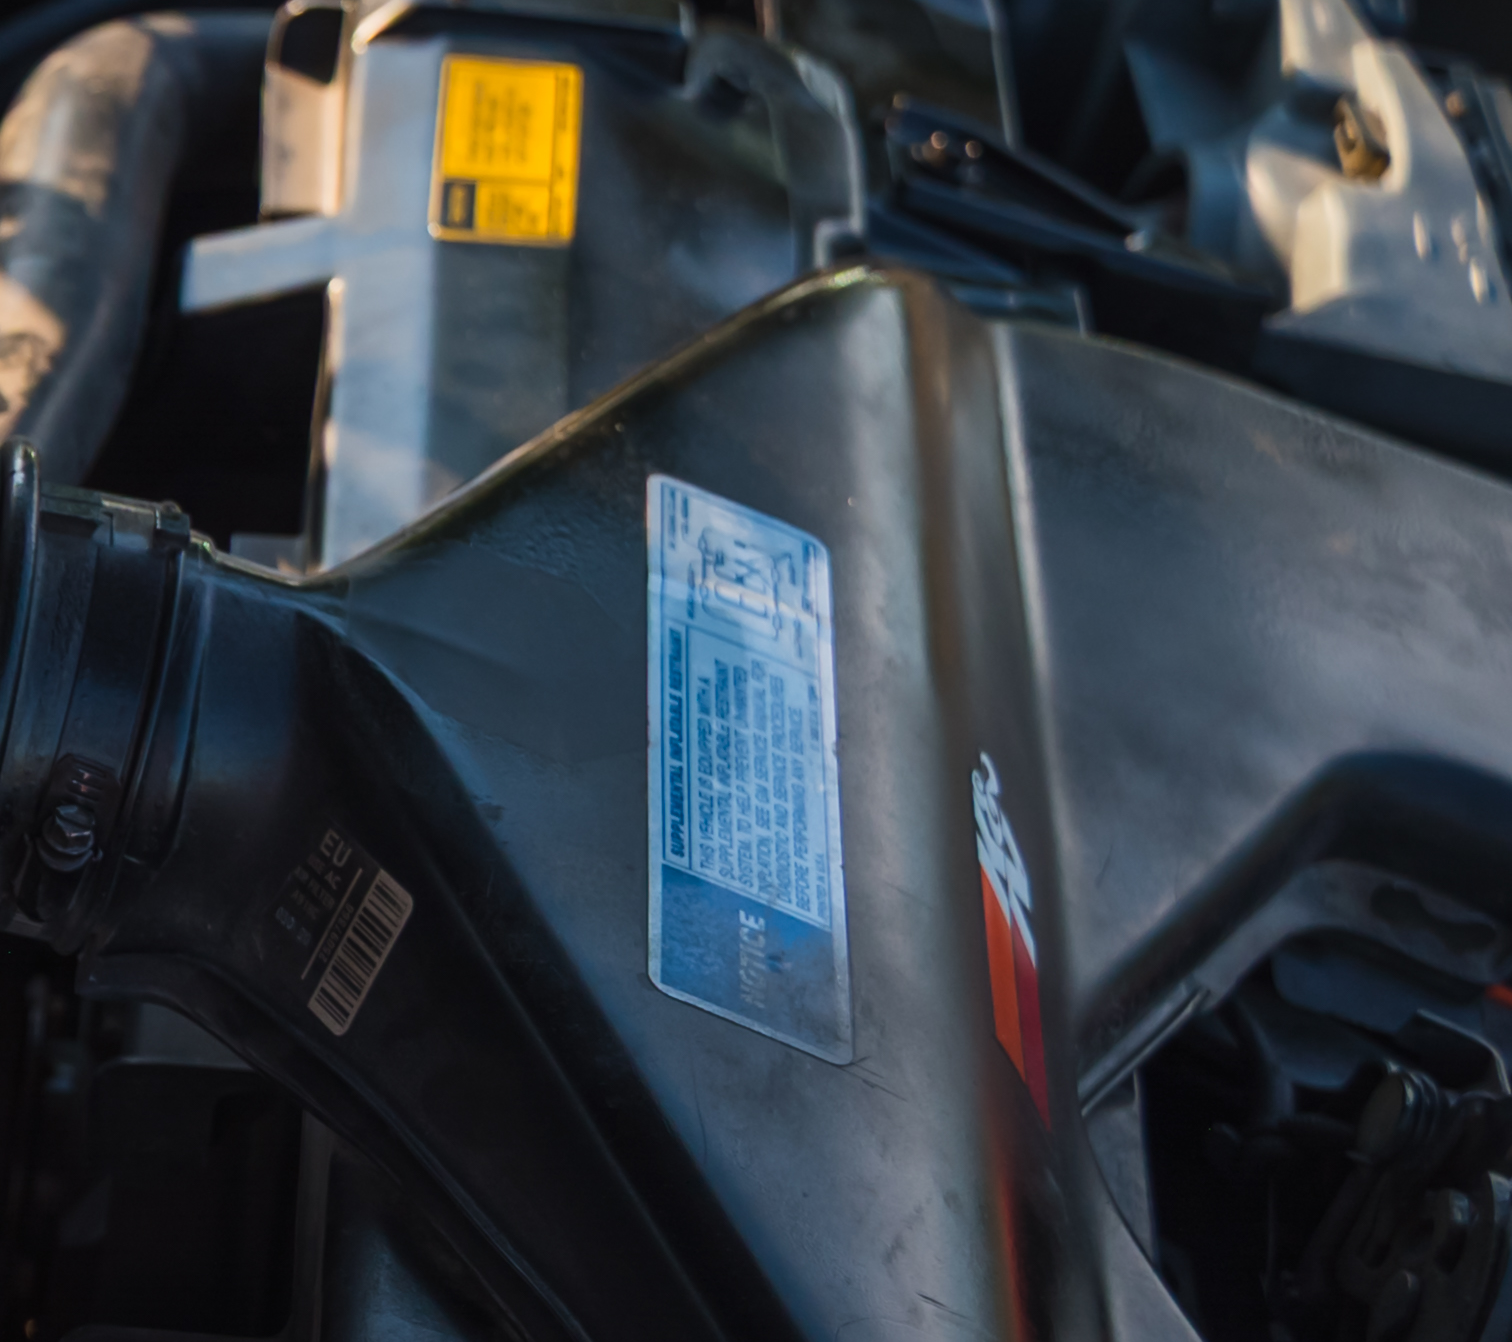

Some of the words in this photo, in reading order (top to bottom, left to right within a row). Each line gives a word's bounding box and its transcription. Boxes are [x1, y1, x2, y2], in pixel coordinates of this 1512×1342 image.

[698, 716, 712, 777] EQUIPPED
[734, 729, 750, 784] PREVENT
[753, 732, 769, 783] SERVICE
[790, 756, 806, 782] ANY
[735, 783, 751, 817] HELP
[772, 752, 788, 803] SERVICE
[669, 761, 683, 858] SUPPLEMENTAL
[698, 790, 713, 843] VEHICLE
[736, 816, 751, 836] TO
[755, 804, 770, 831] SEE
[773, 802, 788, 830] AND
[791, 782, 808, 862] PERFORMING
[319, 828, 352, 868] EU
[699, 842, 713, 872] THIS
[774, 829, 790, 904] DIAGNOSTIC
[793, 861, 810, 912] BEFORE
[737, 907, 768, 1011] NOTICE
